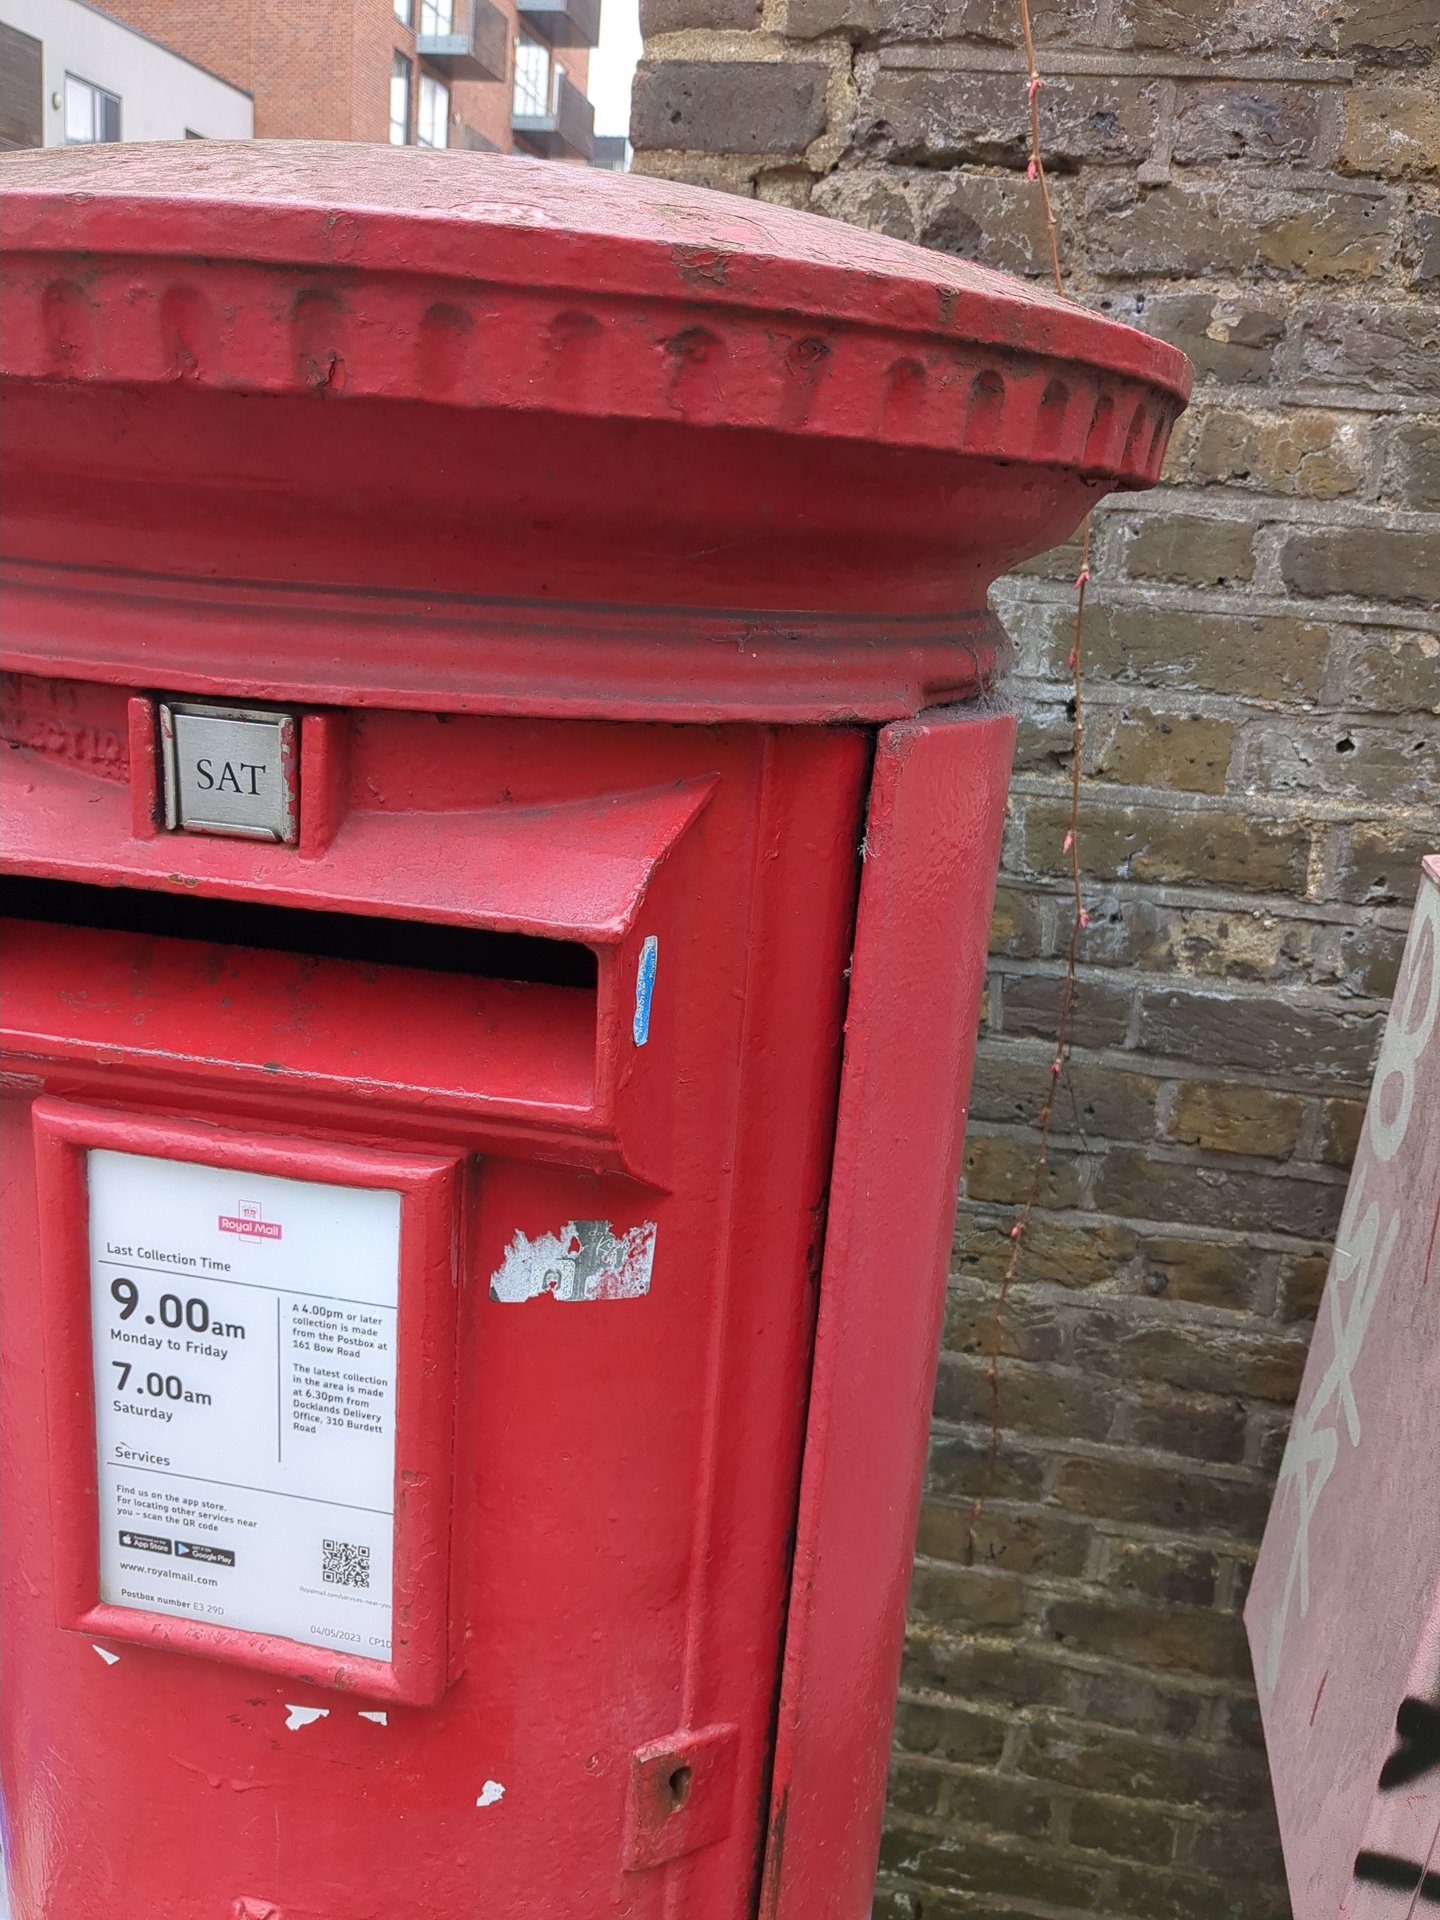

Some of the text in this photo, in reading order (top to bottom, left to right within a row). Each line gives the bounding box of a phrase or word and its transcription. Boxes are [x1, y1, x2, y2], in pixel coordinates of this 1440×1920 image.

[196, 759, 266, 796] SAT
[222, 1218, 279, 1236] Royal Mail
[108, 1243, 231, 1272] Last Collection Time
[110, 1278, 246, 1339] 9.00am
[293, 1304, 383, 1325] A 4.00pm or later
[293, 1317, 337, 1330] collection
[352, 1327, 378, 1336] made
[111, 1329, 228, 1359] Monday to Friday
[293, 1328, 315, 1338] from
[319, 1333, 334, 1341] the
[338, 1335, 374, 1348] Postbox
[293, 1340, 360, 1358] 161 Bow Road
[112, 1361, 212, 1405] 7.00am
[293, 1363, 388, 1386] The latest collection
[293, 1375, 384, 1397] in the area is made
[306, 1389, 343, 1403] 6.30pm
[347, 1397, 369, 1408] from
[114, 1401, 173, 1422] Saturday
[293, 1400, 381, 1423] Docklands Delivery
[293, 1411, 383, 1434] Office, 310 Burdett
[293, 1423, 316, 1433] Road
[115, 1447, 171, 1466] Services
[116, 1484, 227, 1512] Find us on the app store.
[117, 1496, 258, 1528] For locating other services near
[117, 1508, 133, 1516] you
[143, 1512, 162, 1521] scan
[166, 1514, 180, 1525] the
[183, 1519, 195, 1528] QR
[199, 1521, 218, 1531] code
[133, 1539, 168, 1552] App Store
[192, 1550, 232, 1565] Google Play
[120, 1562, 218, 1587] www.royalmail.com
[121, 1589, 154, 1602] Postbox
[157, 1595, 191, 1609] number
[194, 1602, 204, 1611] E3
[310, 1626, 361, 1642] 04/05/2023
